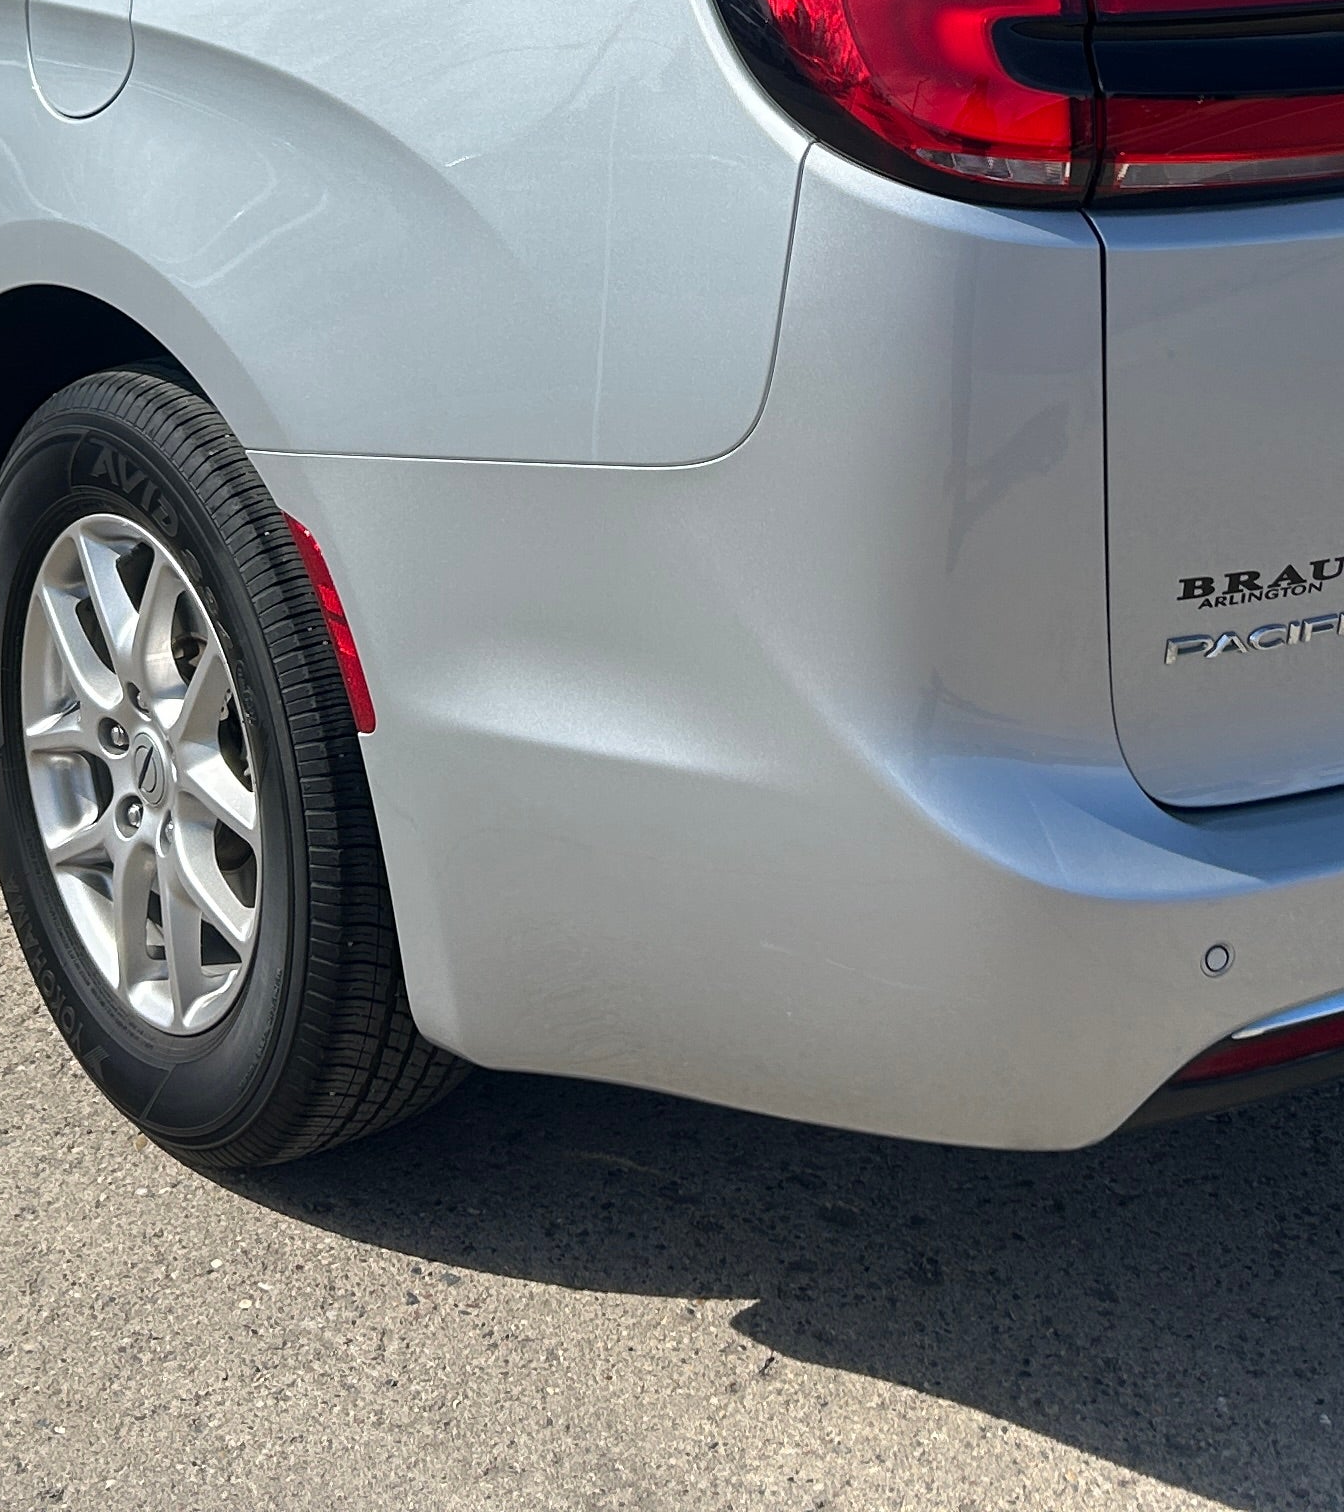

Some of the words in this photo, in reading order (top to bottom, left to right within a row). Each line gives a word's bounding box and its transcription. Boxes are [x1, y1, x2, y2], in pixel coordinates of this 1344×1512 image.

[88, 437, 179, 538] AVID
[1197, 581, 1323, 610] ARLINGTON
[5, 872, 84, 1054] YOKOHAMA
